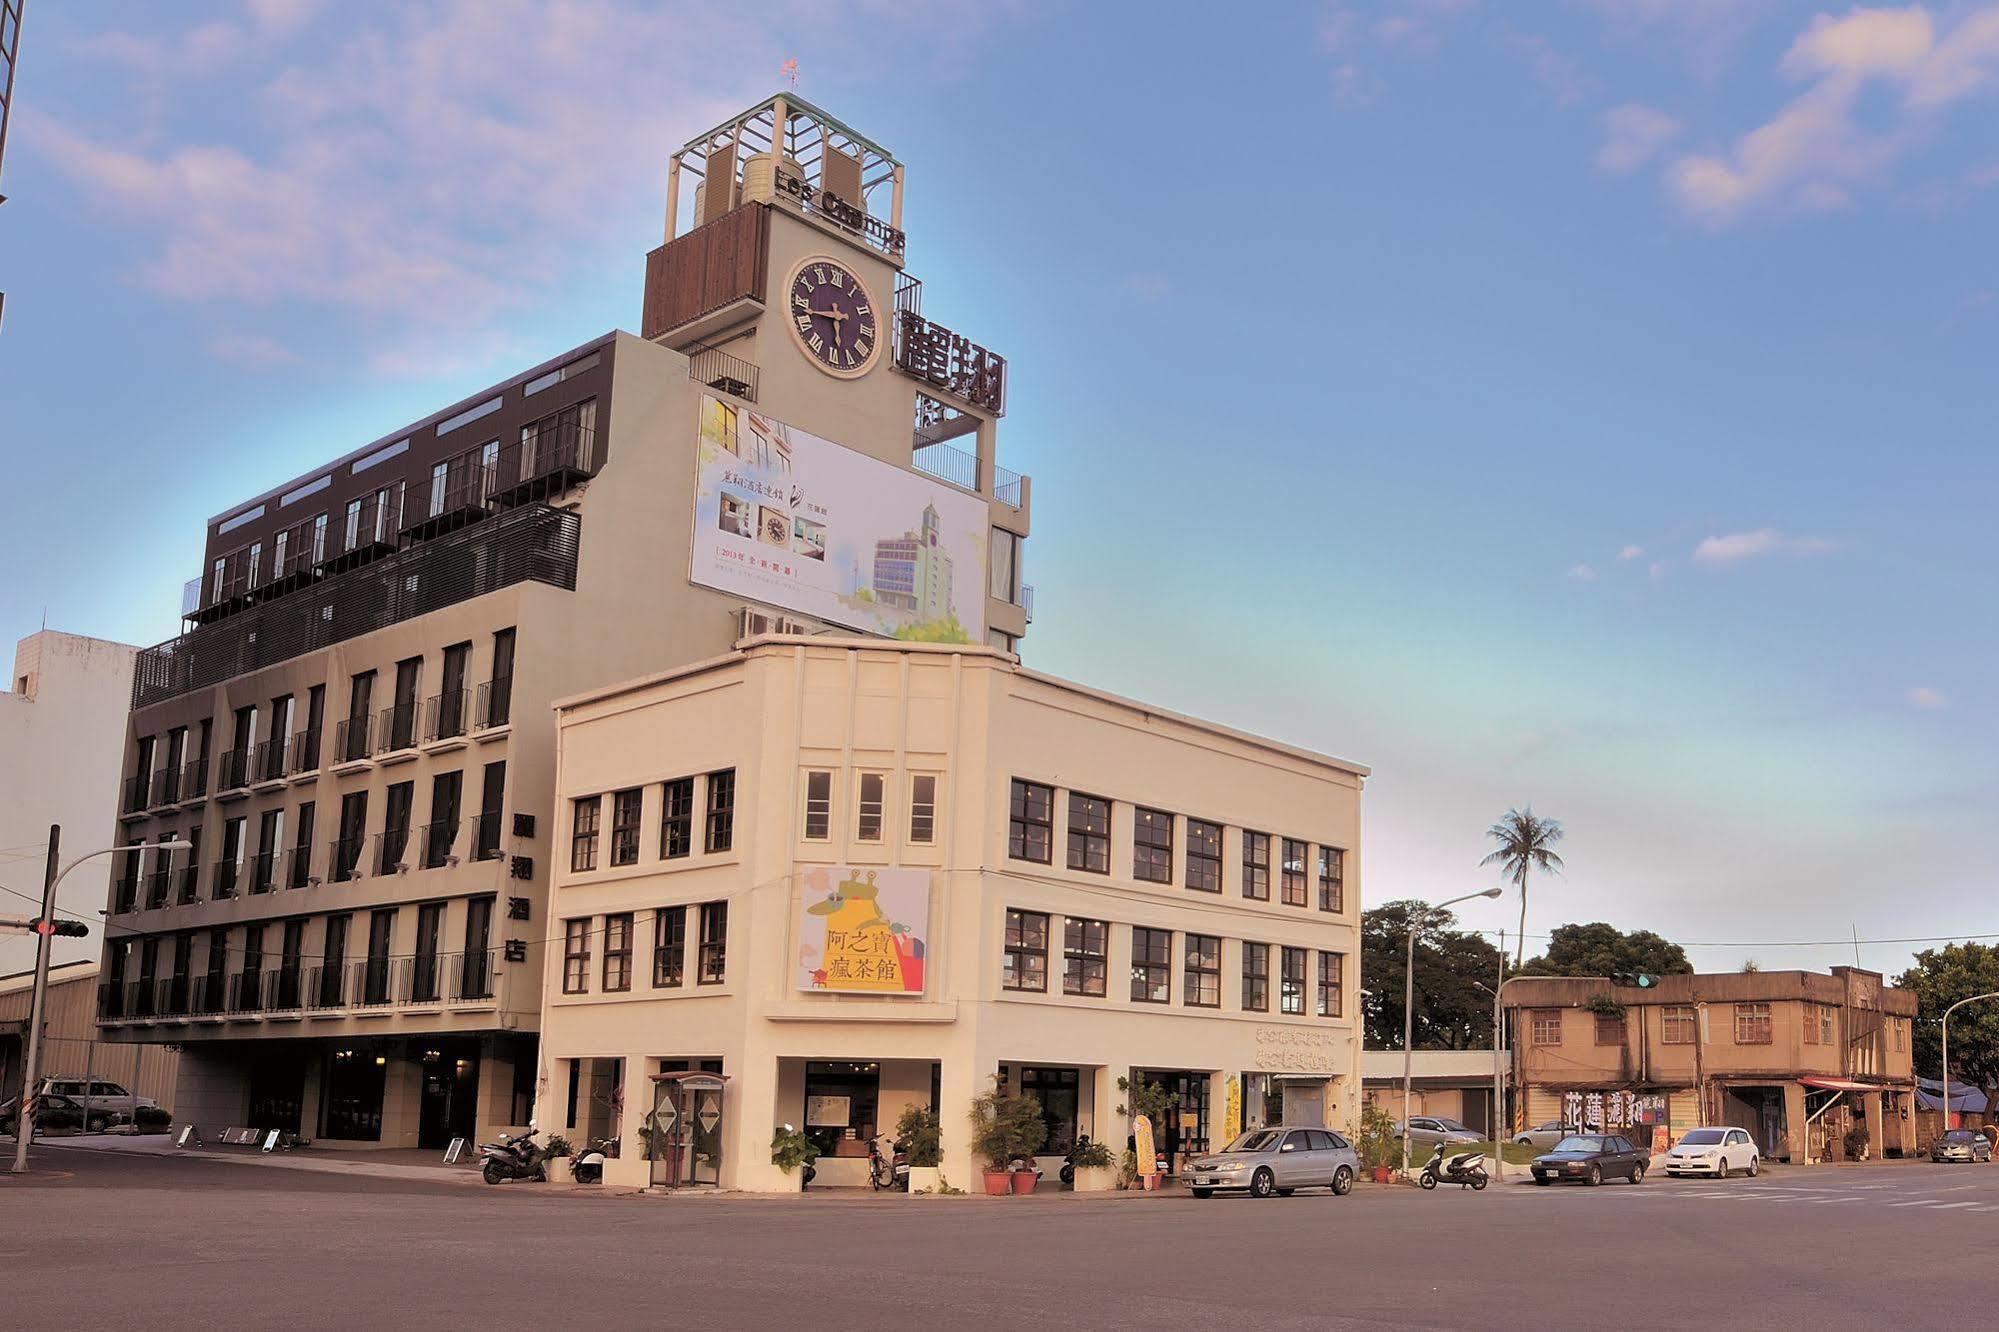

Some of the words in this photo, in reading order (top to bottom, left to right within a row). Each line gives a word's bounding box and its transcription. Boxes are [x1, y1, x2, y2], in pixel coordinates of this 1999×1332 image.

[800, 276, 815, 293] X
[831, 269, 844, 288] XII
[847, 285, 858, 298] I
[856, 305, 870, 316] II
[859, 323, 874, 339] III
[846, 349, 855, 365] V
[830, 956, 898, 980] 瘋茶館
